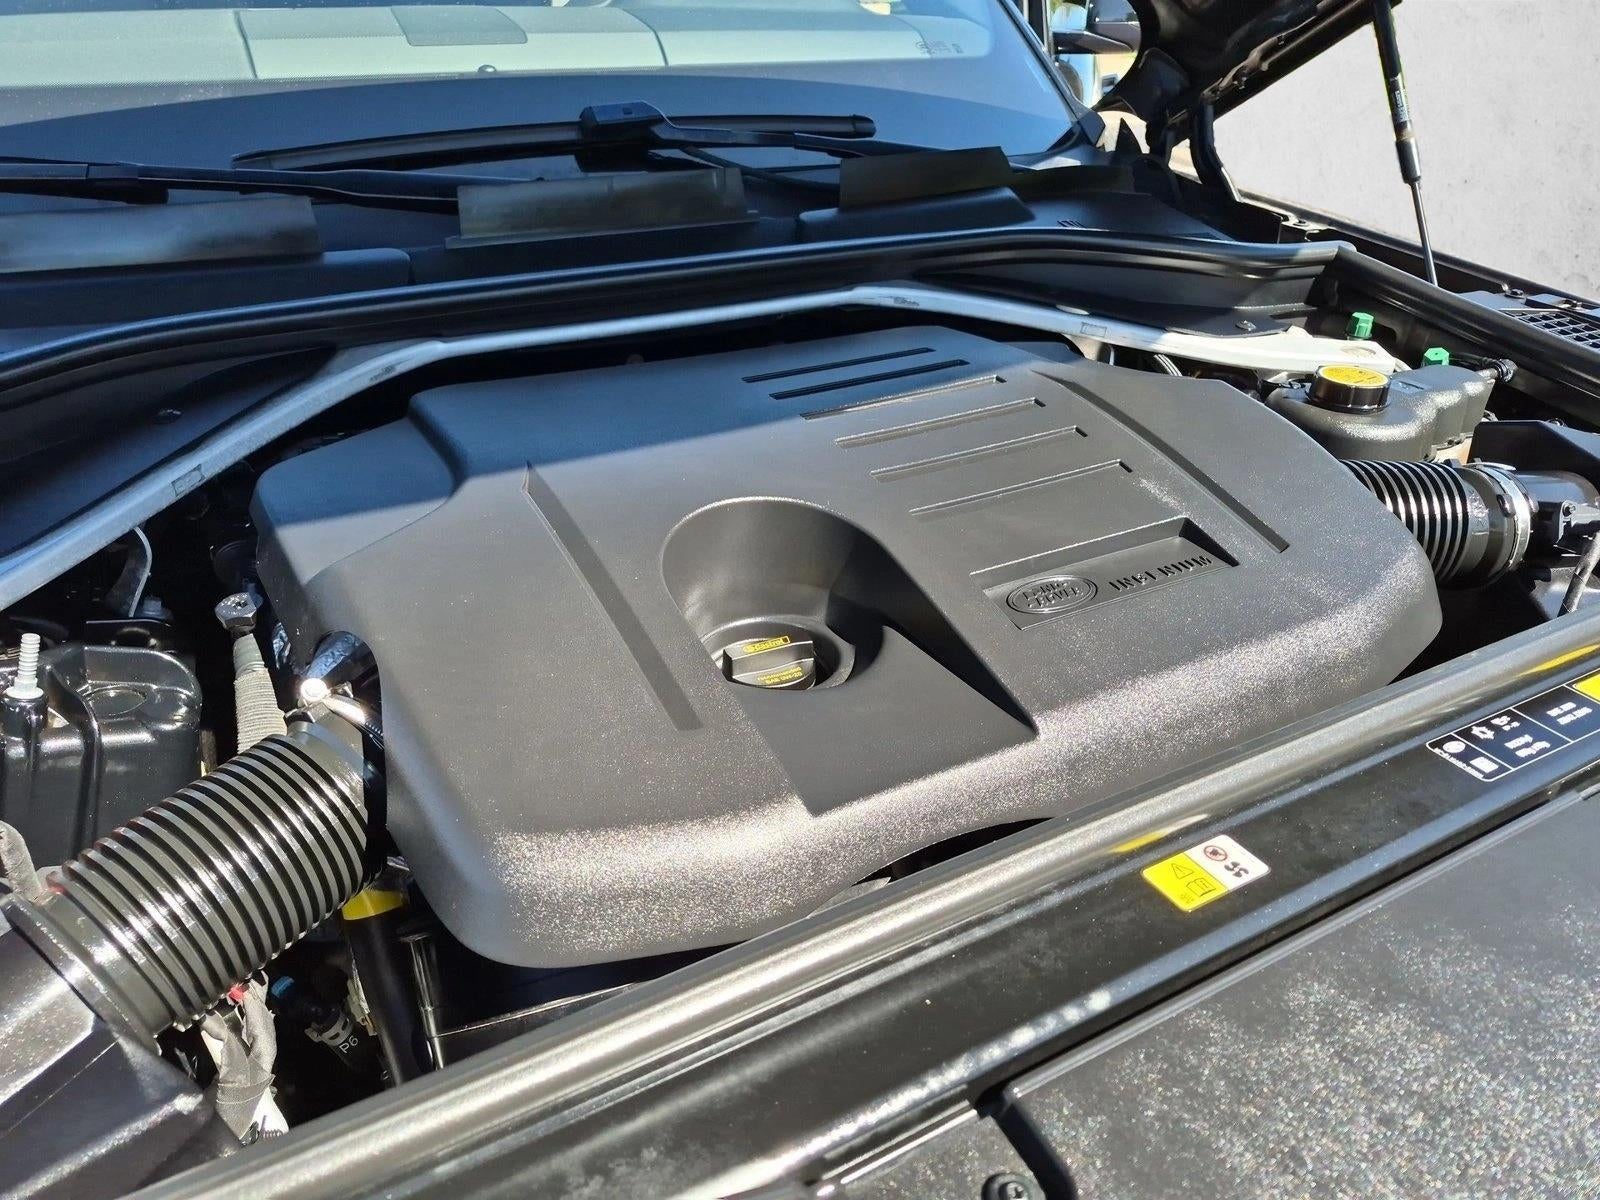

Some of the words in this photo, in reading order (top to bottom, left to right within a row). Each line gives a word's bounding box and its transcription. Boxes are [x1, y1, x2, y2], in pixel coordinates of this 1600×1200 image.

[1108, 555, 1212, 591] INGENIUM
[1034, 586, 1083, 608] ROVER
[339, 1036, 358, 1053] P6
